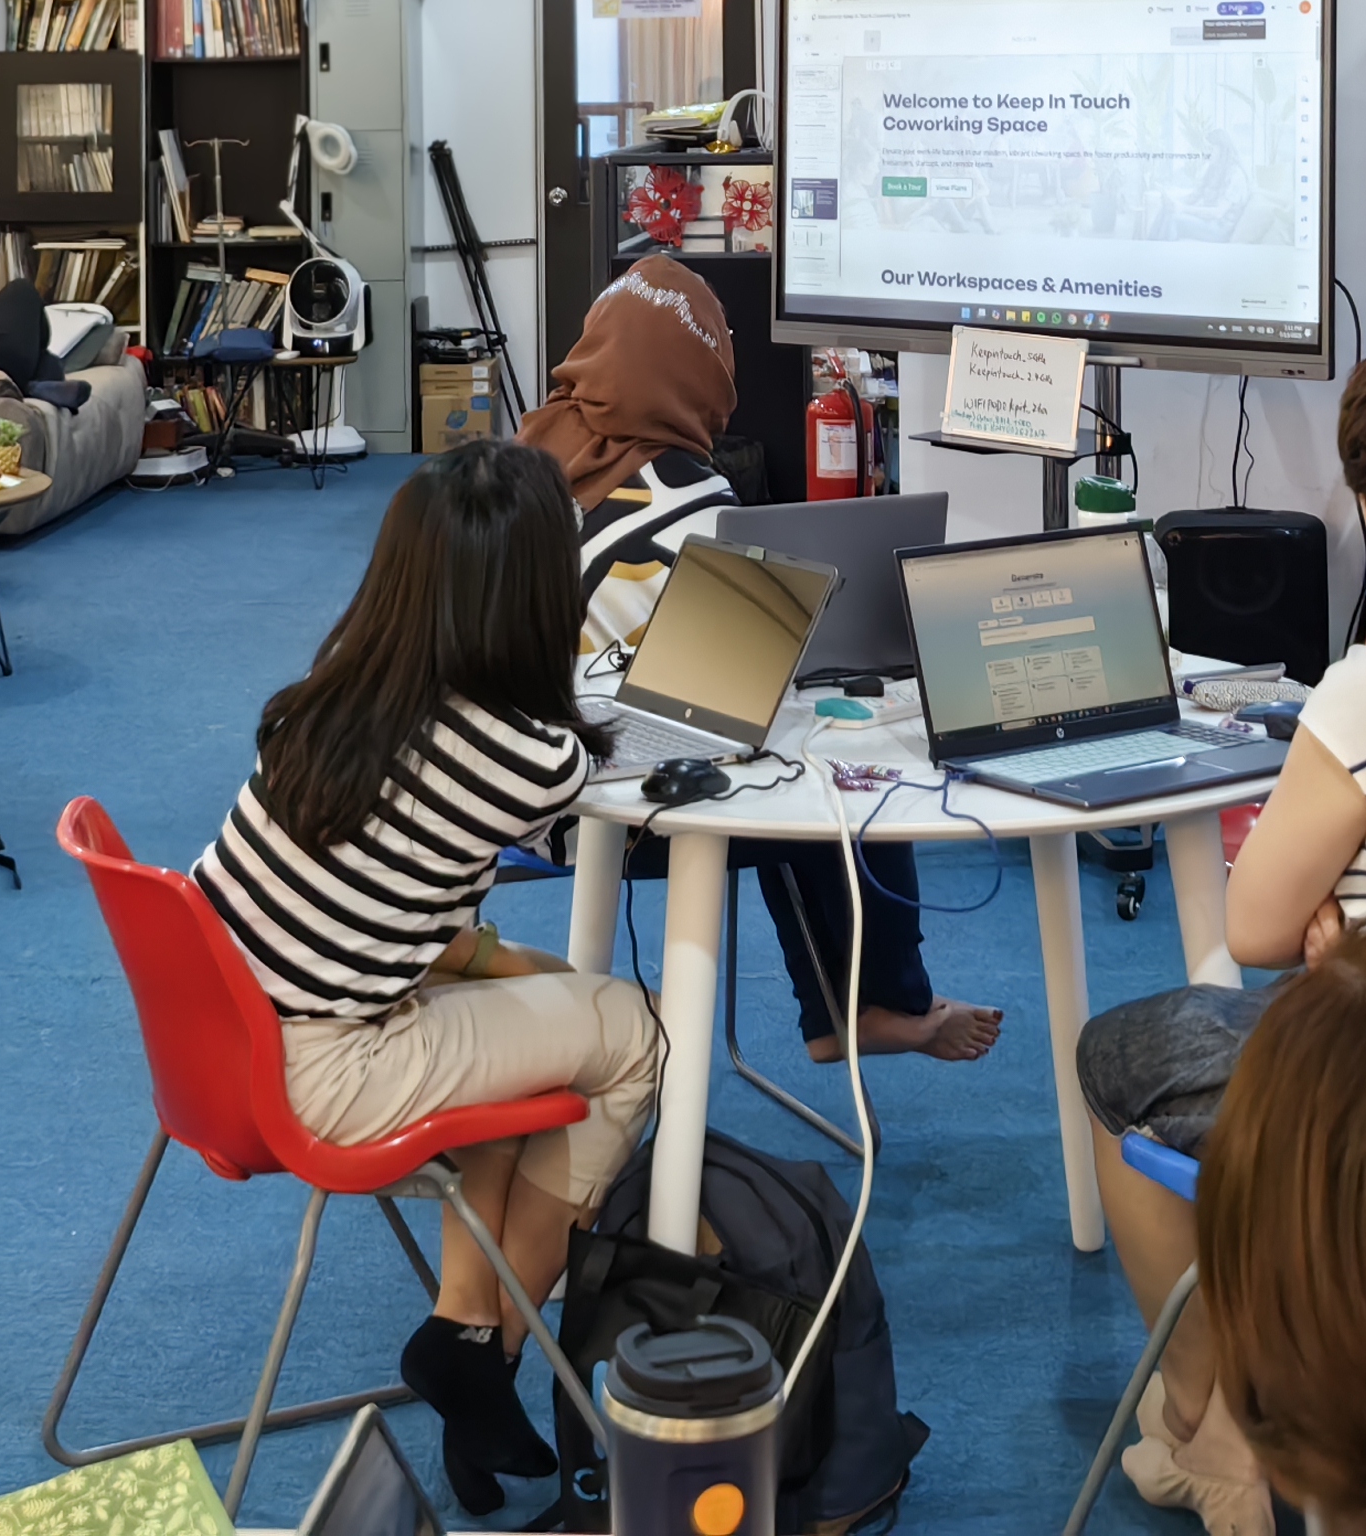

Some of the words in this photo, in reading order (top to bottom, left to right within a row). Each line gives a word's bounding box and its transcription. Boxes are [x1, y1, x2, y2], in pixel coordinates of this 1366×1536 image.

[883, 93, 969, 109] Welcome
[972, 94, 993, 109] to
[997, 93, 1045, 112] Keep
[1048, 93, 1066, 109] In
[1069, 93, 1131, 109] Touch
[883, 115, 983, 135] Coworking
[987, 116, 1048, 135] Space
[881, 269, 915, 286] Our
[917, 270, 1038, 292] Workspaces
[1041, 276, 1057, 294] &
[1059, 277, 1163, 299] Amenities
[963, 397, 986, 411] WIFI
